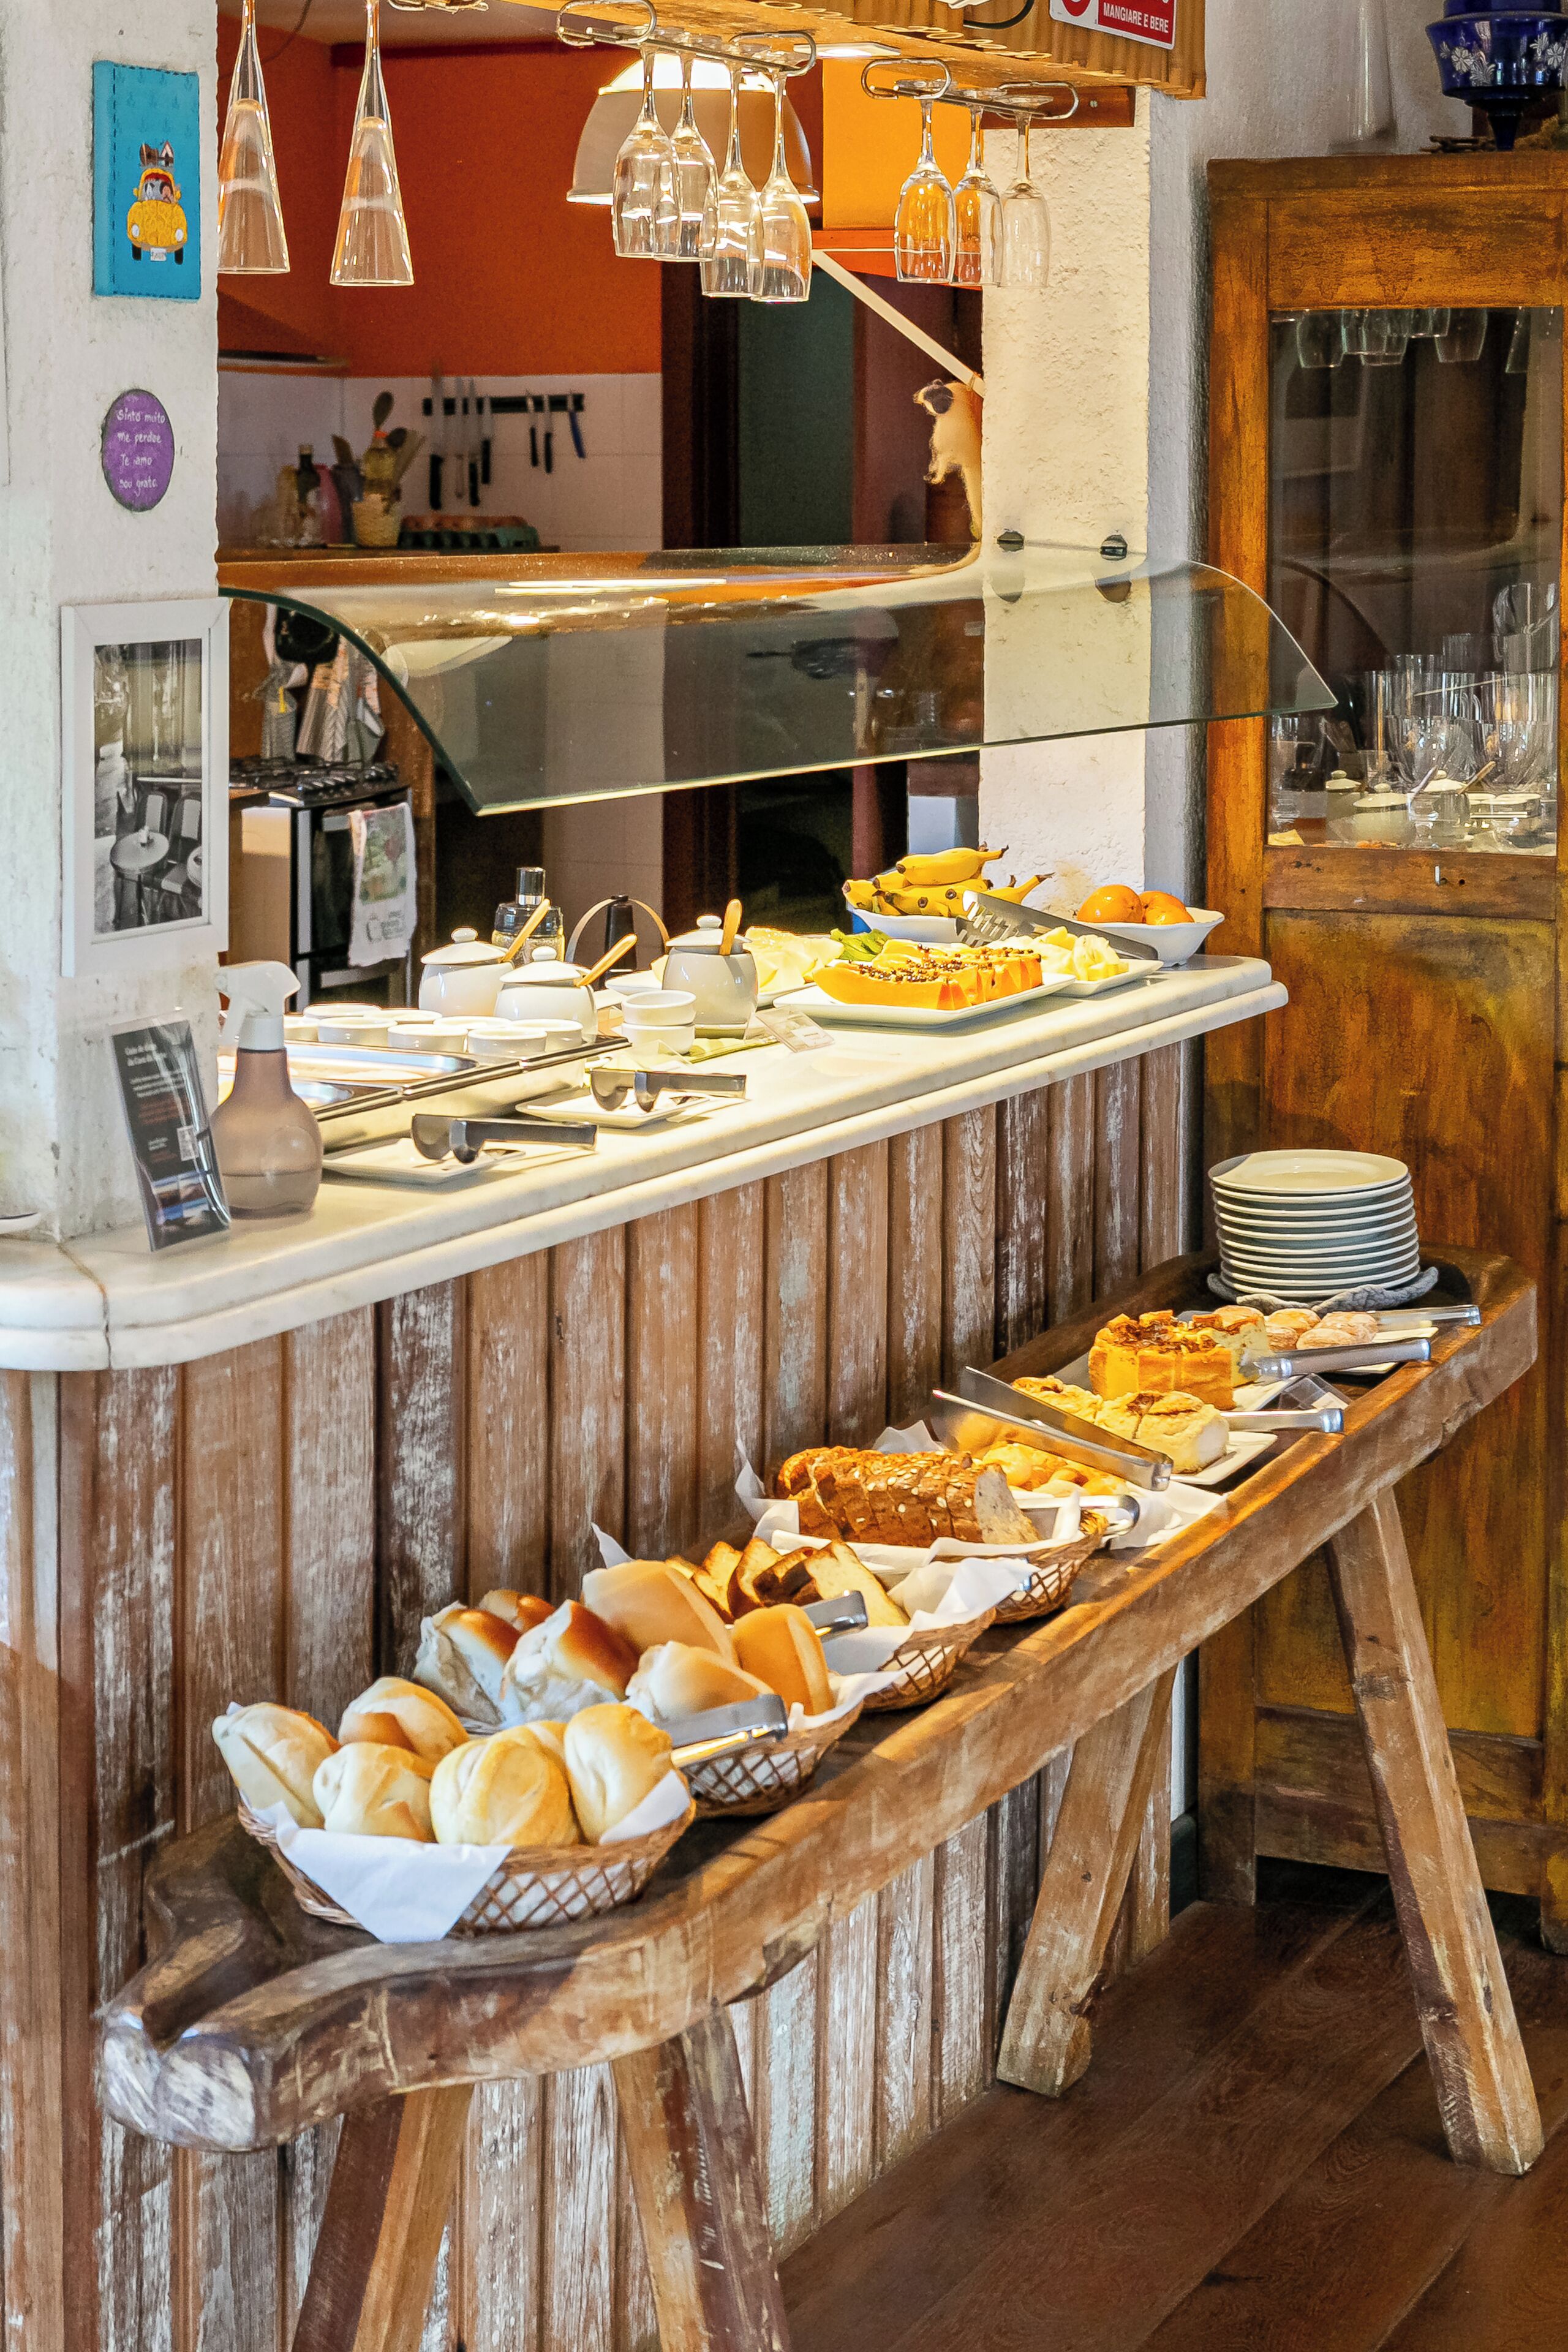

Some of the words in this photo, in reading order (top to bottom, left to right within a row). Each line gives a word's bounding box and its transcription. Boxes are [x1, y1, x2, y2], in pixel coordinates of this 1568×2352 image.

[1103, 2, 1142, 26] MANGIARE
[1144, 14, 1148, 28] E
[1150, 15, 1169, 33] BERE
[116, 407, 140, 423] Sinto
[145, 412, 166, 424] muito
[121, 453, 130, 466] Te
[134, 456, 153, 466] amo
